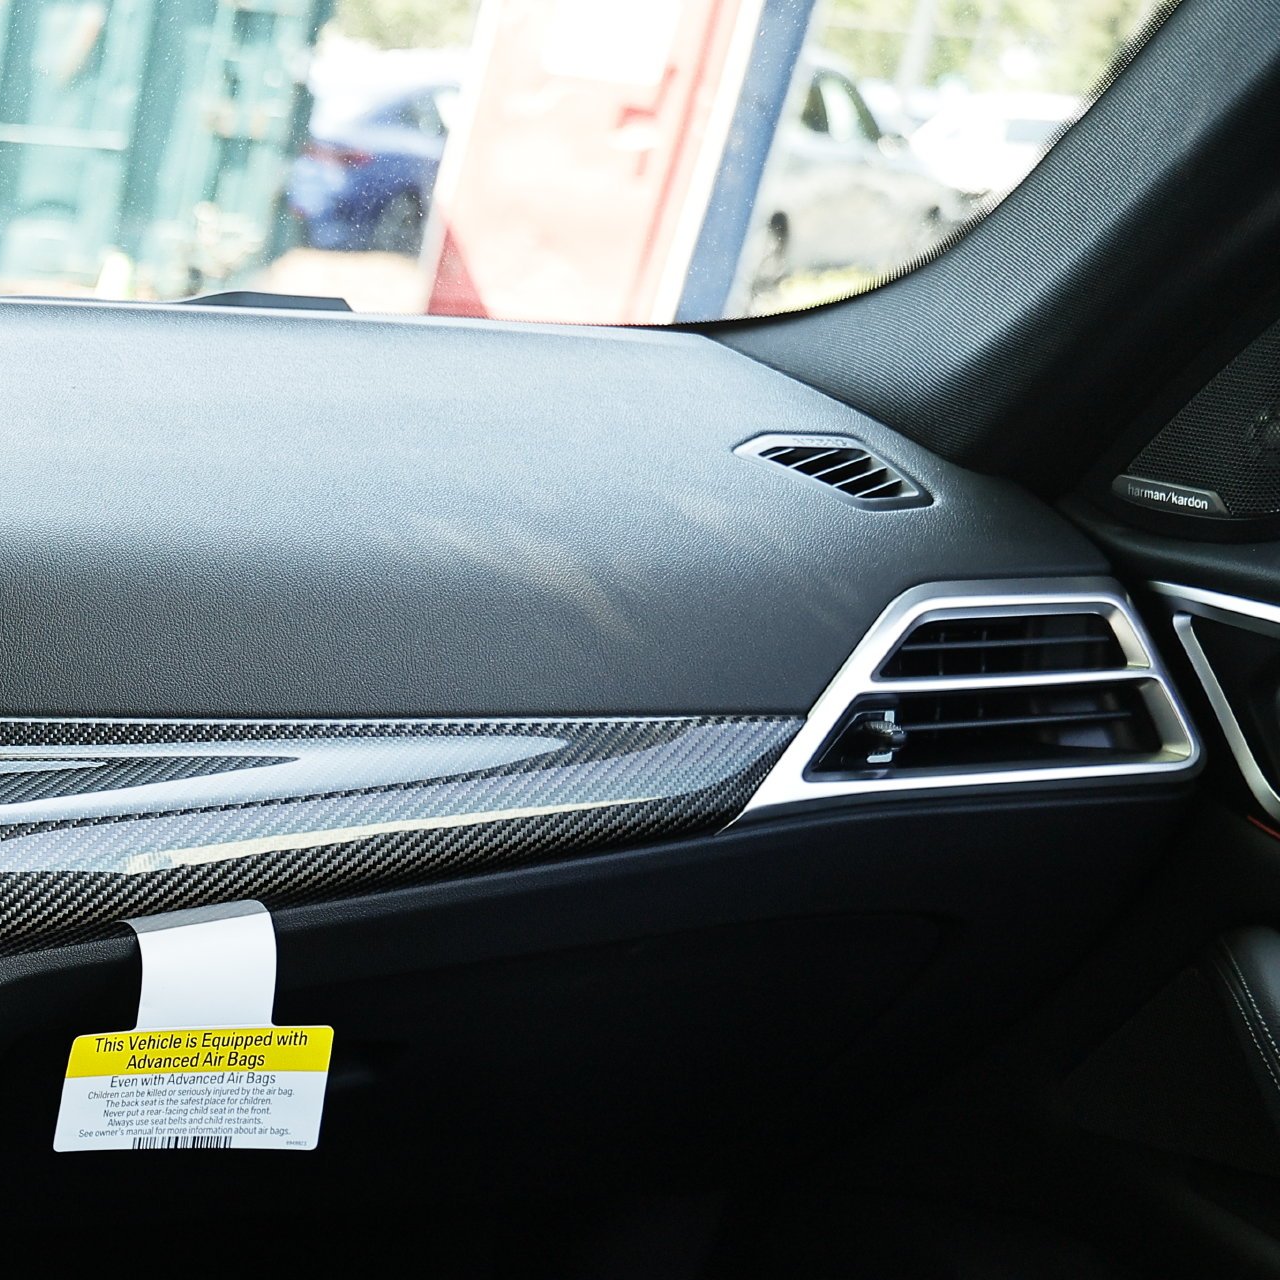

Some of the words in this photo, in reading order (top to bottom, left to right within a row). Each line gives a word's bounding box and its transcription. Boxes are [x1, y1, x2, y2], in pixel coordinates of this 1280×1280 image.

[1128, 484, 1208, 510] harman/kardon
[95, 1037, 124, 1052] This
[129, 1034, 181, 1051] Vehicle
[186, 1033, 197, 1048] is
[202, 1031, 273, 1050] Equipped
[277, 1031, 308, 1046] with
[126, 1052, 200, 1069] Advanced
[202, 1052, 224, 1067] Air
[227, 1051, 265, 1069] Bags
[111, 1076, 137, 1088] Even
[142, 1074, 164, 1086] with
[167, 1073, 225, 1085] Advanced
[227, 1072, 244, 1084] Air
[246, 1072, 275, 1087] Bags
[88, 1091, 119, 1099] Children
[147, 1089, 166, 1097] killed
[178, 1088, 212, 1097] seriously
[213, 1087, 240, 1097] injured
[241, 1087, 250, 1097] by
[278, 1088, 294, 1097] bag.
[121, 1099, 139, 1107] back
[180, 1097, 204, 1105] safest
[204, 1097, 225, 1106] place
[240, 1096, 272, 1105] children.
[126, 1109, 139, 1118] put
[146, 1107, 188, 1116] rear-facing
[190, 1107, 208, 1115] child
[236, 1106, 249, 1114] the
[251, 1106, 271, 1114] front.
[107, 1119, 134, 1127] Always
[204, 1116, 223, 1124] child
[224, 1116, 263, 1124] restraints.
[79, 1129, 94, 1138] See
[95, 1128, 124, 1137] owner's
[126, 1127, 154, 1136] manual
[155, 1127, 165, 1136] for
[189, 1127, 233, 1135] information
[234, 1126, 256, 1135] about
[270, 1127, 291, 1136] bags.
